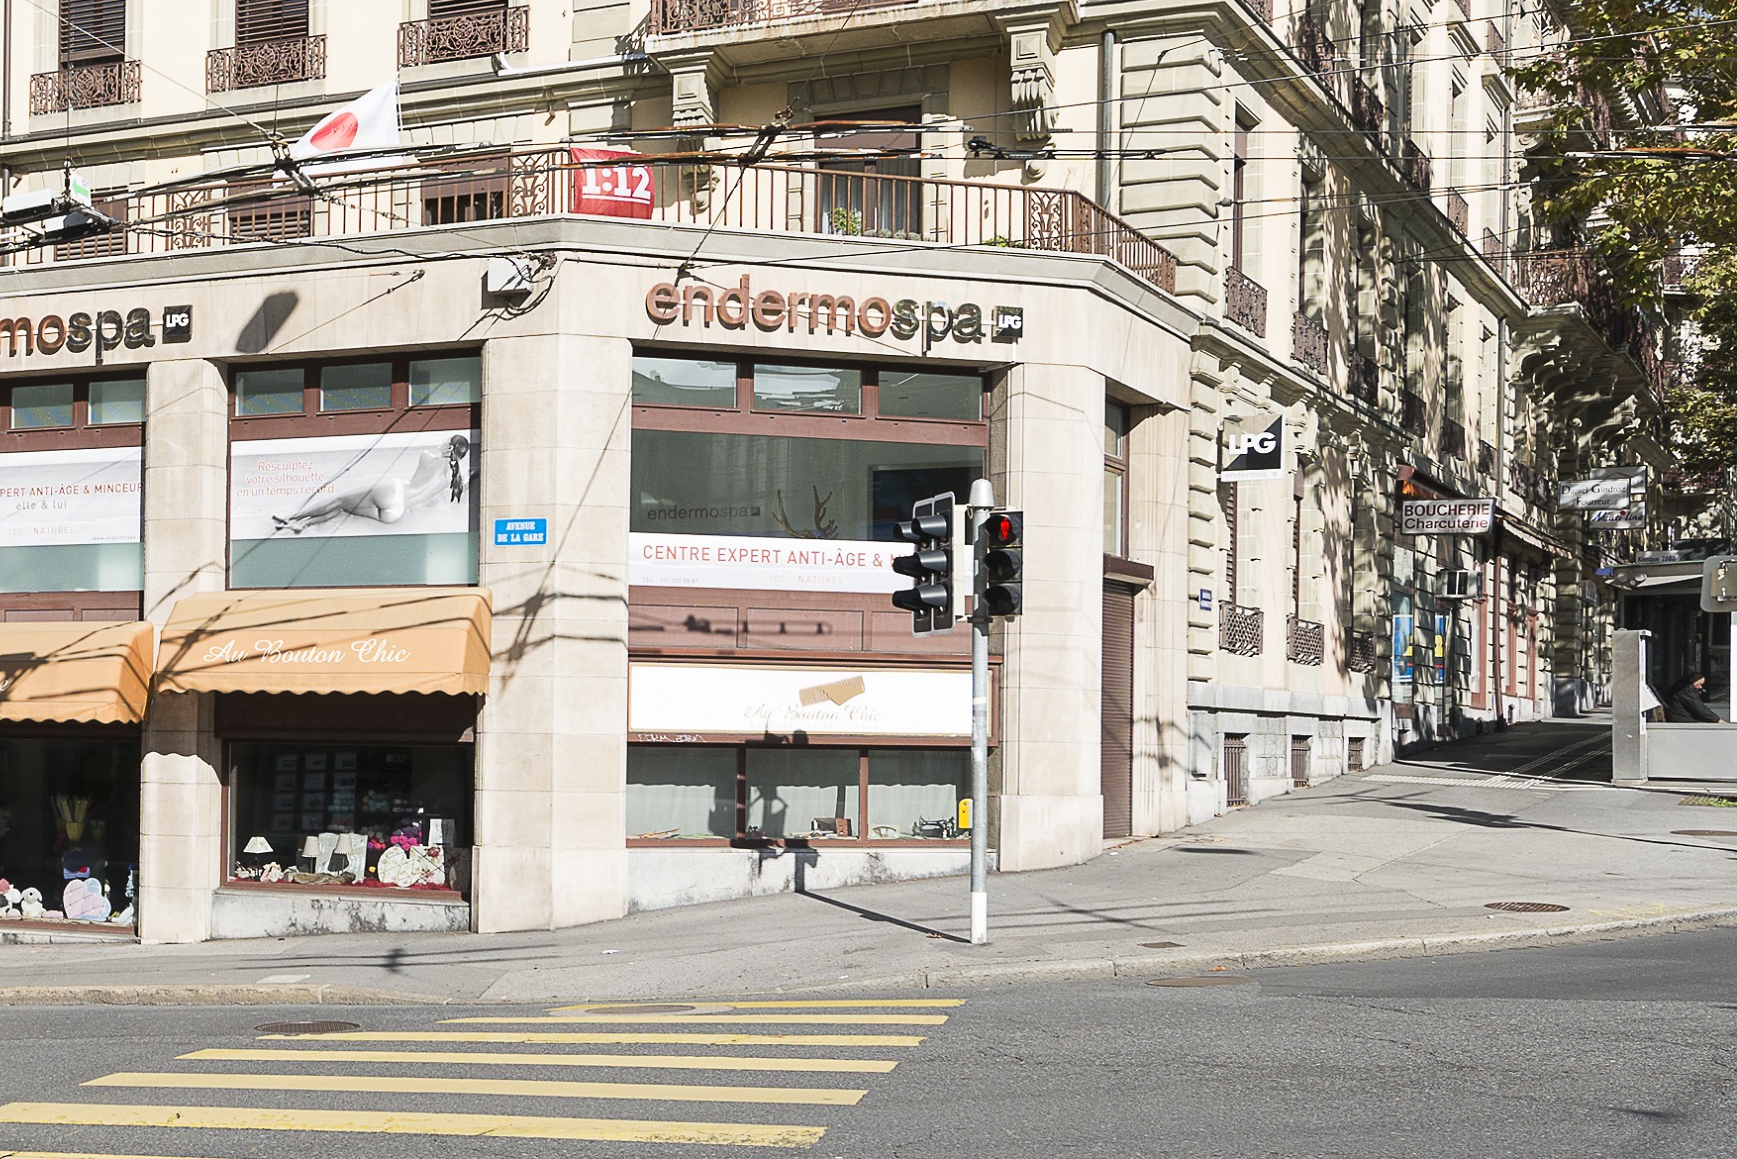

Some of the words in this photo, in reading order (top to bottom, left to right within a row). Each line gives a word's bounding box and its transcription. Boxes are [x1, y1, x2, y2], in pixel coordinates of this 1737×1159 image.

[582, 166, 652, 200] 1:12
[165, 312, 191, 329] LPG
[646, 274, 985, 356] endermospa
[997, 313, 1023, 330] LPG
[1229, 431, 1276, 455] LPG
[258, 461, 313, 472] Resculptez
[247, 474, 273, 484] votre
[275, 473, 324, 483] silhouette
[29, 483, 79, 496] ANTI-ÂGE
[83, 485, 90, 494] &
[94, 483, 144, 494] MINCEUR
[237, 489, 249, 497] en
[251, 488, 264, 496] un
[267, 487, 298, 498] temps
[300, 484, 334, 494] record
[16, 501, 36, 510] elle
[41, 500, 48, 510] &
[53, 499, 67, 509] lui
[1404, 503, 1490, 517] BOUCHERIE
[647, 504, 749, 522] endermospa
[506, 521, 536, 530] AVENUE
[1404, 517, 1488, 529] Charcuterie
[33, 526, 75, 535] NATUREL
[497, 533, 508, 542] DE
[510, 533, 521, 542] LA
[523, 532, 544, 542] GARE
[642, 545, 711, 562] CENTRE
[717, 547, 781, 563] EXPERT
[787, 547, 866, 567] ANTI-ÂGE
[872, 553, 883, 568] &
[797, 575, 843, 585] NATUREL
[202, 639, 248, 664] Au
[254, 639, 346, 664] Bouton
[351, 638, 411, 664] Chic
